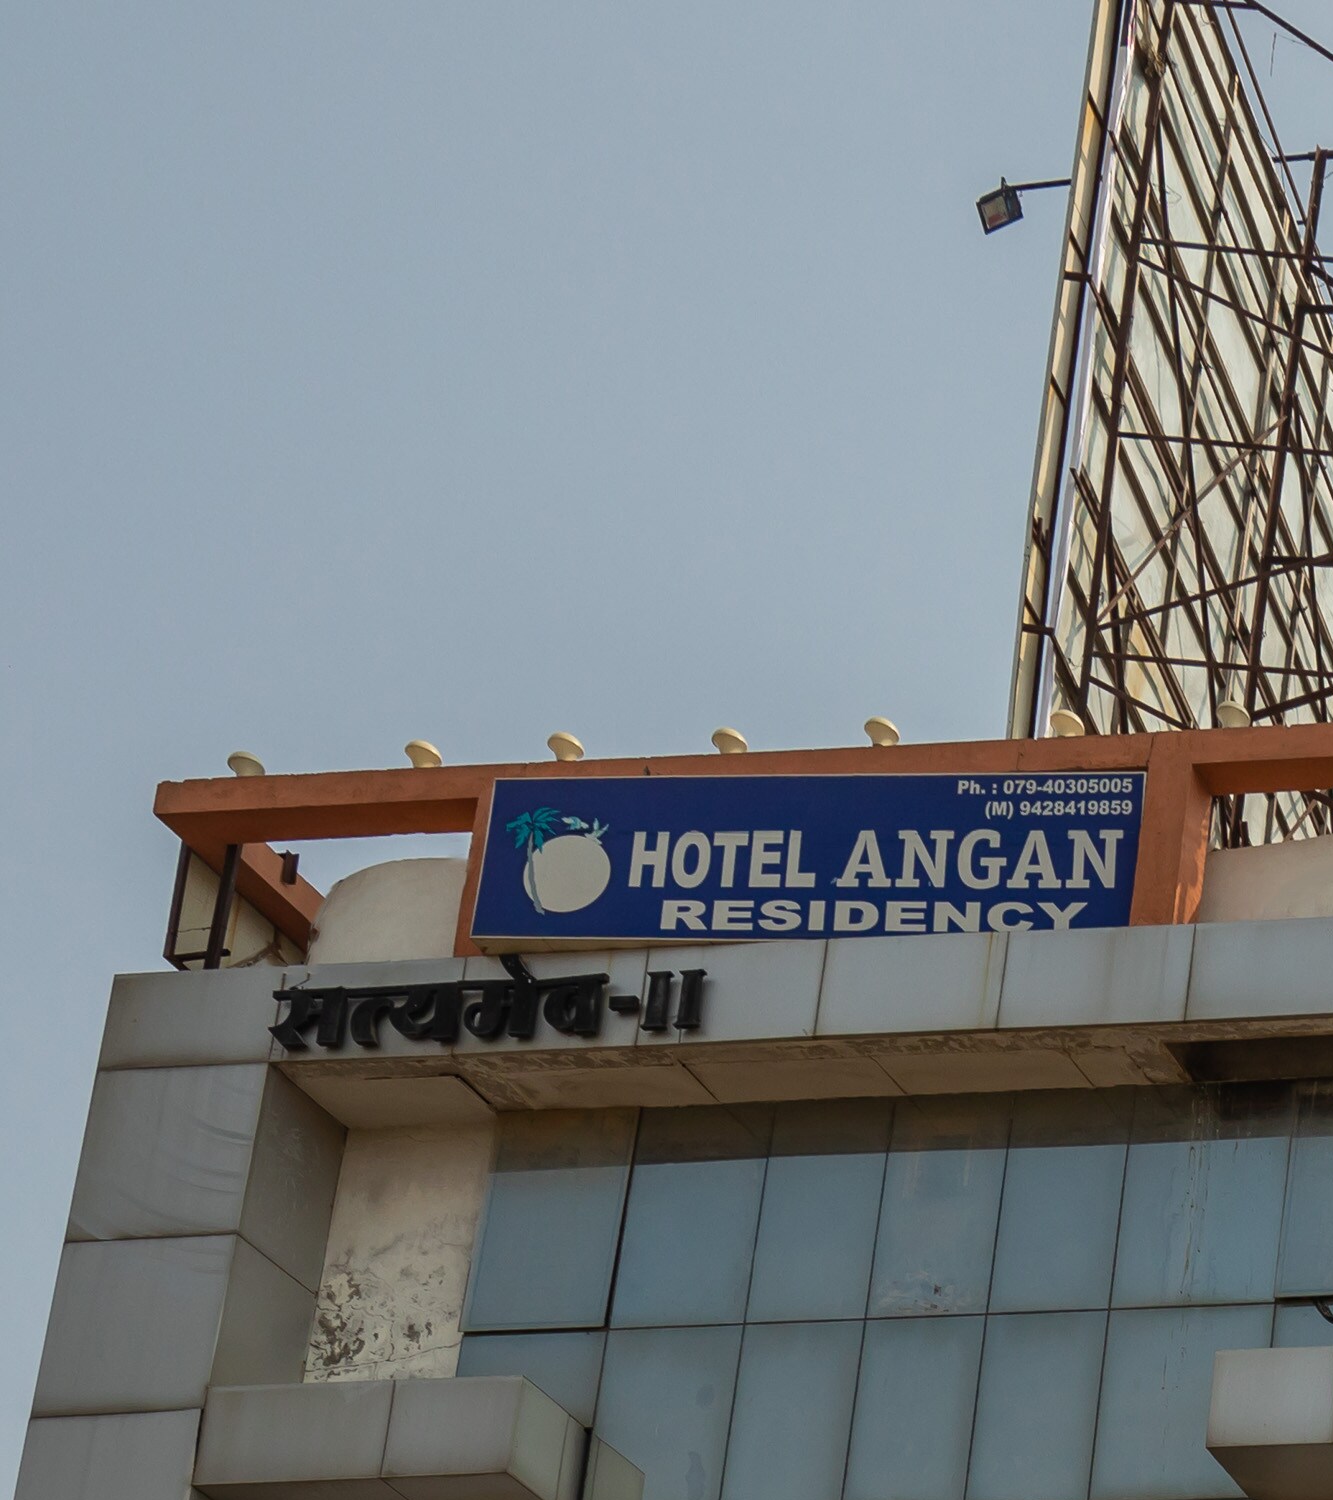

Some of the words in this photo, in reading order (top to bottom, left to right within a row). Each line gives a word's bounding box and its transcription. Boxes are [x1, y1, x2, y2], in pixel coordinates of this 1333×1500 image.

[1003, 777, 1134, 796] 079-40305005
[985, 800, 1015, 820] (M)
[1019, 799, 1133, 818] 9428419859
[627, 830, 817, 888] HOTEL
[835, 828, 1124, 889] ANGAN
[660, 900, 1088, 932] RESIDENCY
